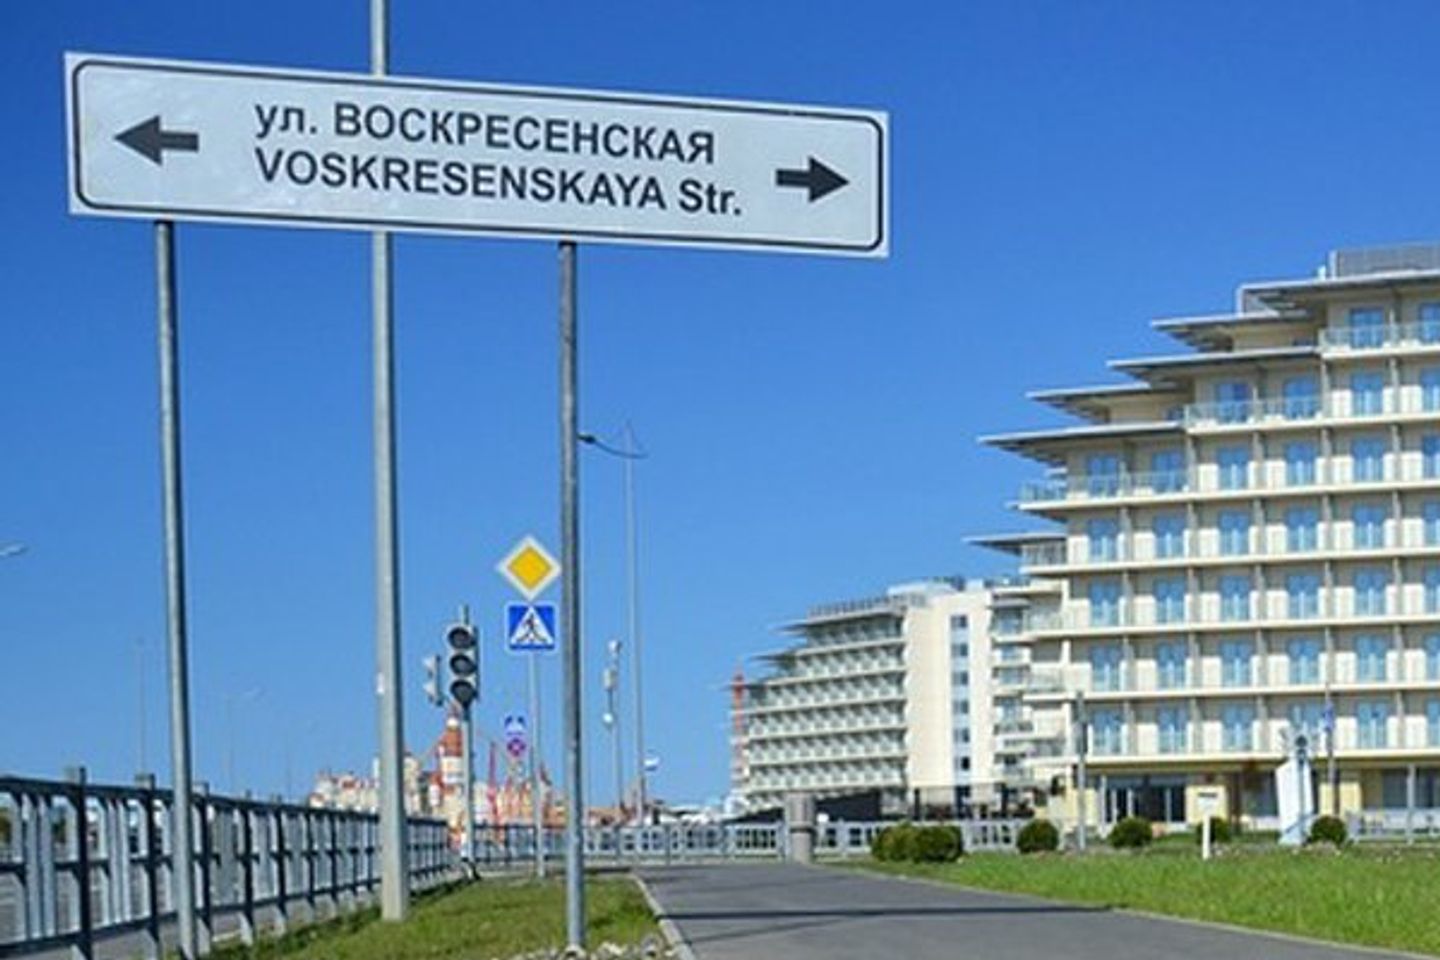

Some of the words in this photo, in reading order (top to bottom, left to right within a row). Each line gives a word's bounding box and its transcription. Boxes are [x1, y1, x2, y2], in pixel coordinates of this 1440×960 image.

[254, 103, 318, 139] ул.
[334, 102, 715, 164] ВОСКРЕСЕНСКАЯ
[254, 147, 667, 210] VOSKRESENSKAYA
[678, 178, 743, 216] Str.
